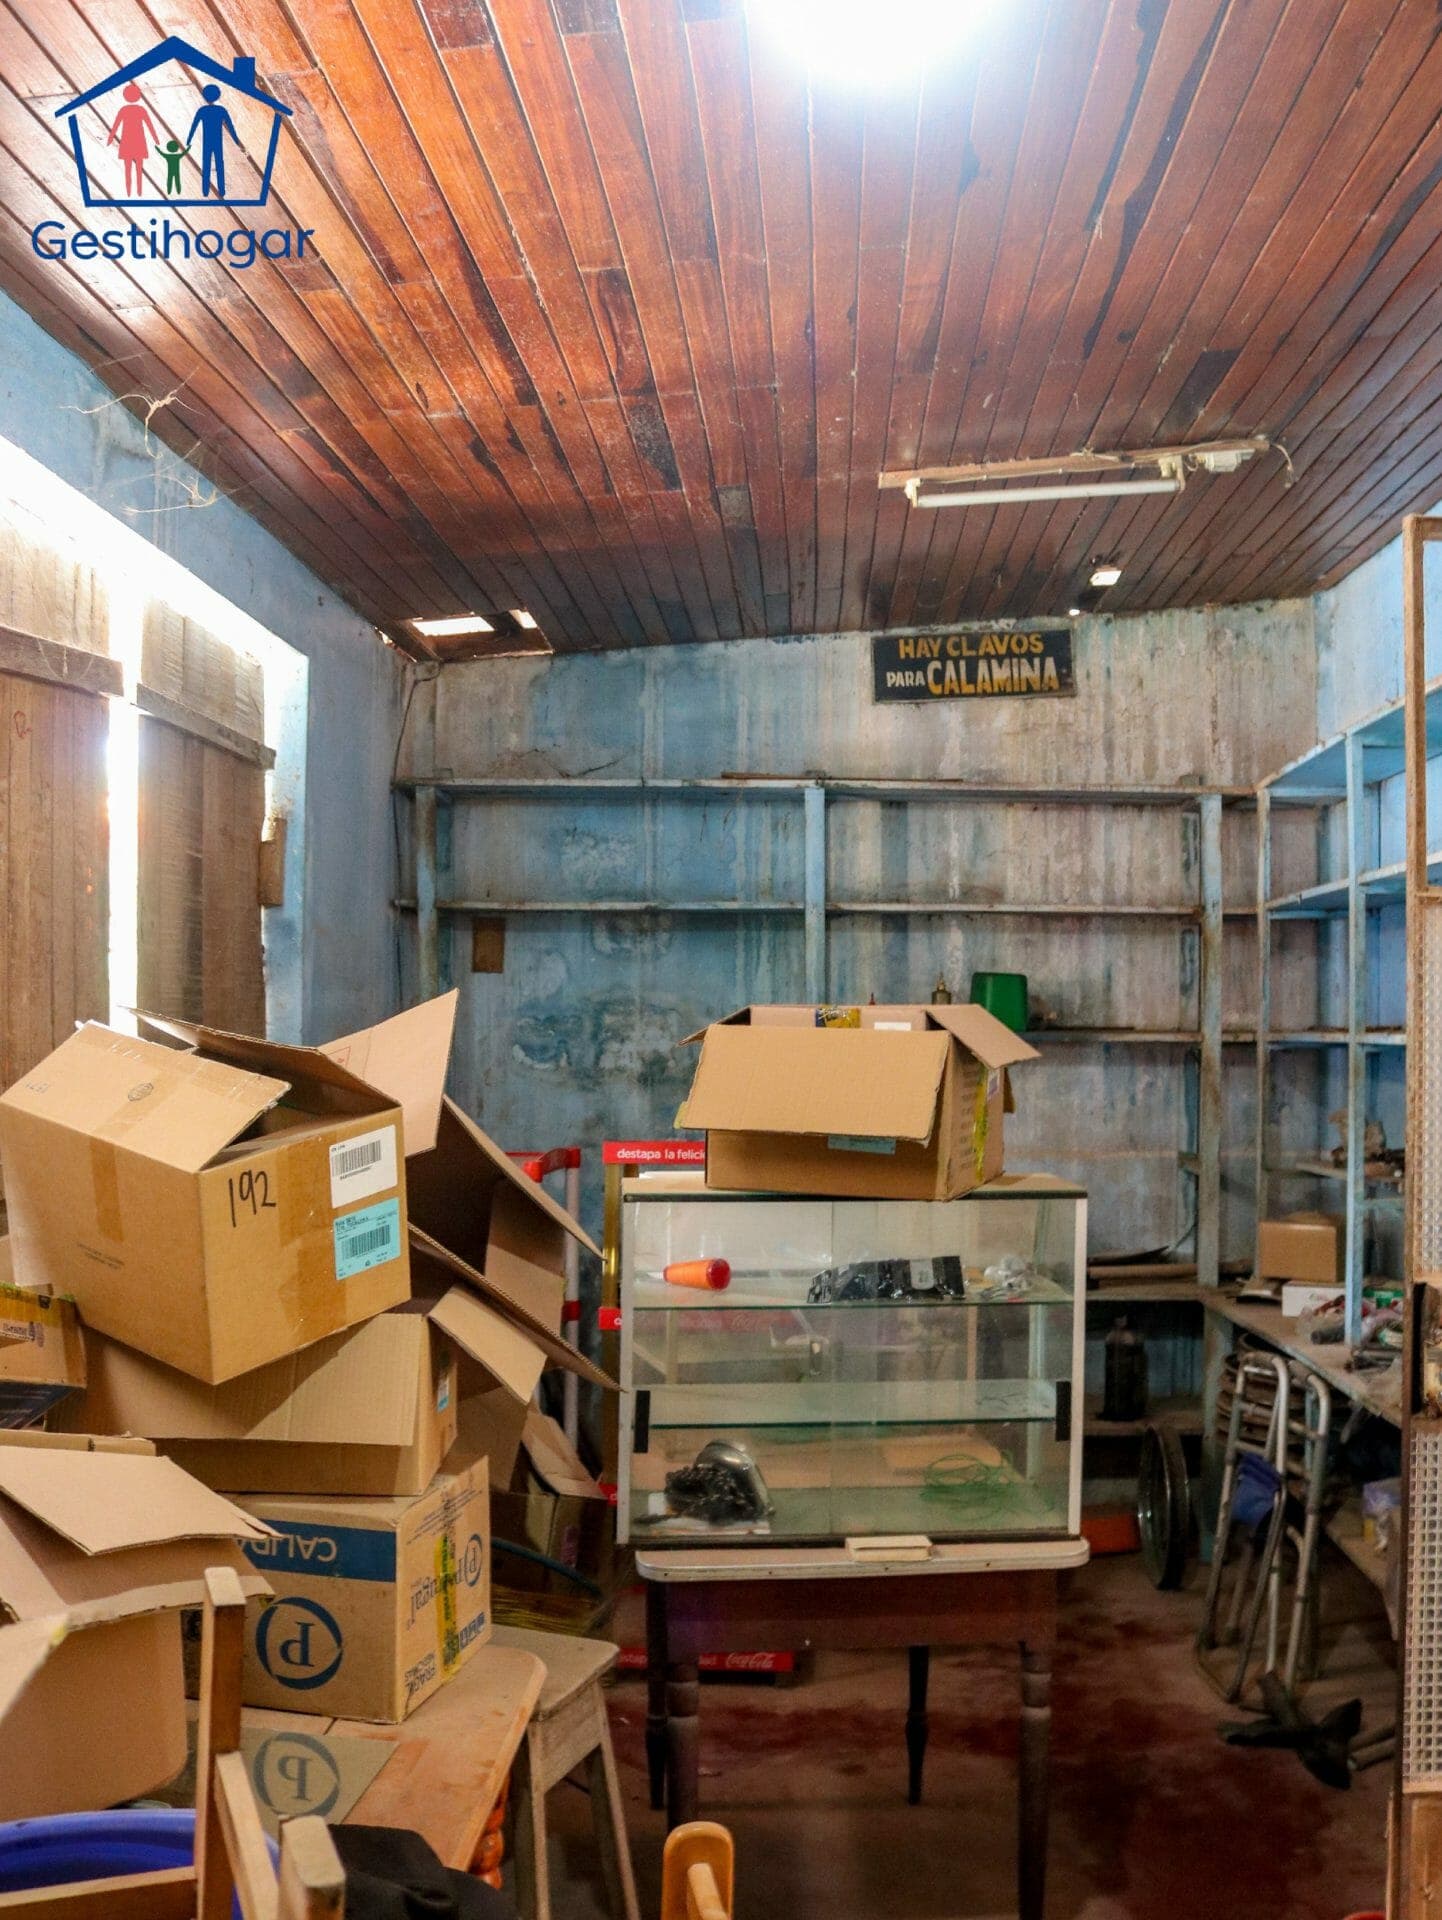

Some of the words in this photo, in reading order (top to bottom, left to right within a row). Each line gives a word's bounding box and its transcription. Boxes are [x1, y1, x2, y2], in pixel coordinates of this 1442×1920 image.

[898, 636, 942, 659] HAY
[946, 632, 1044, 656] CLAVOS
[886, 671, 925, 688] PARA
[926, 656, 1060, 695] CALAMINA
[617, 1148, 661, 1160] destapa
[665, 1149, 675, 1159] la
[677, 1148, 705, 1160] felici
[228, 1169, 276, 1228] 192
